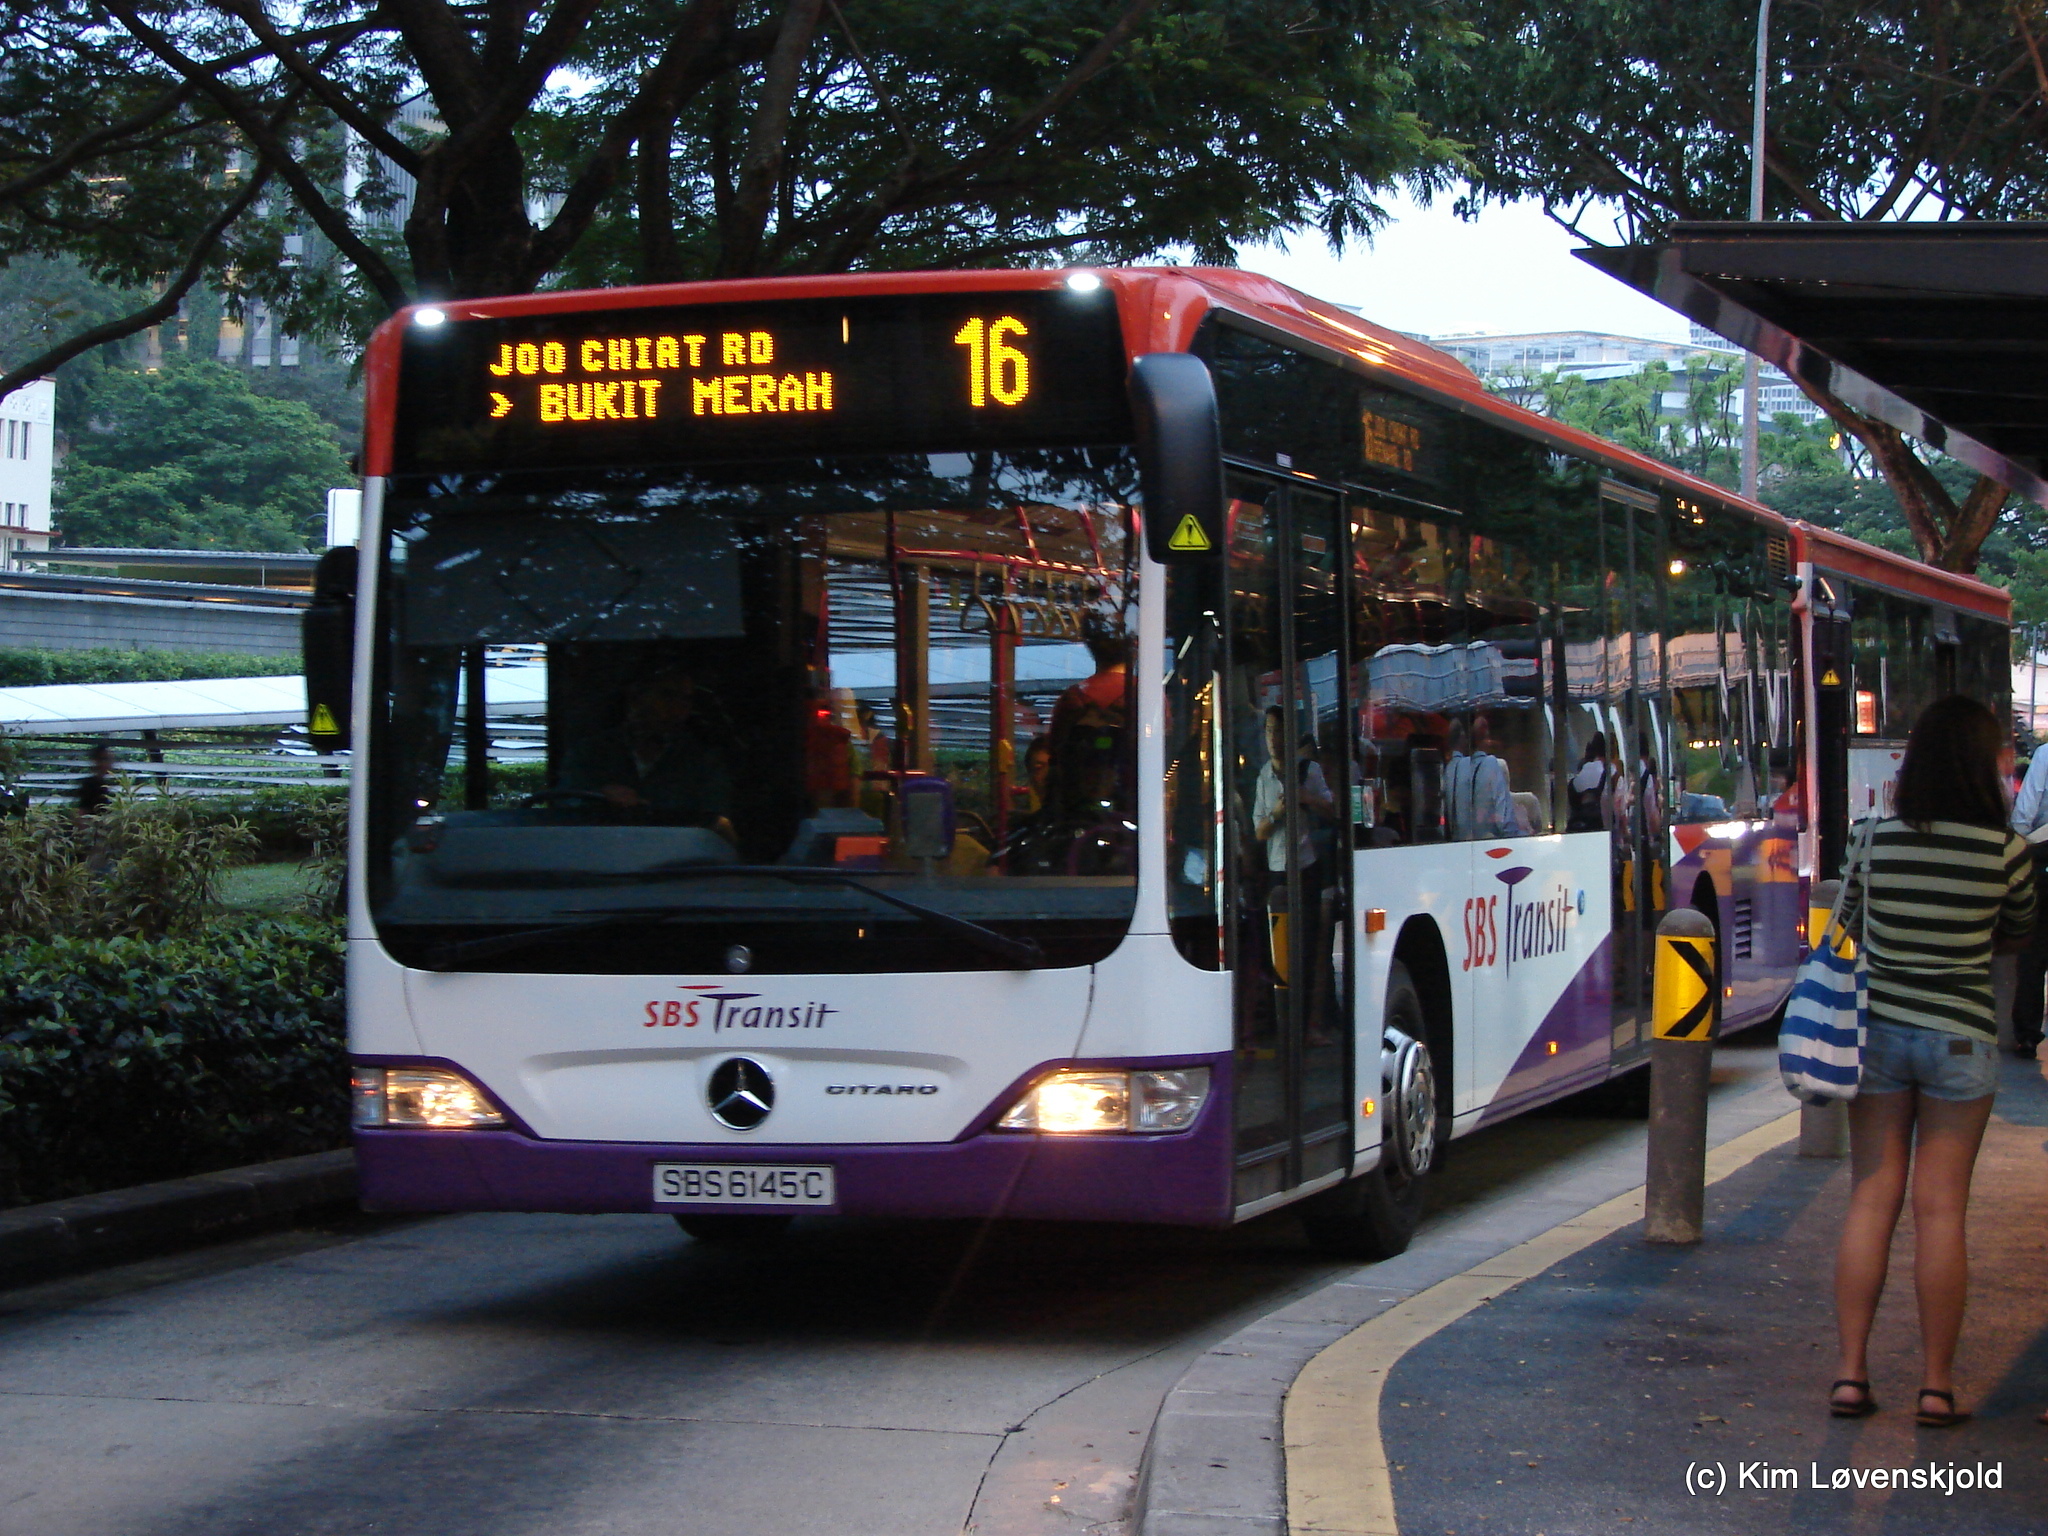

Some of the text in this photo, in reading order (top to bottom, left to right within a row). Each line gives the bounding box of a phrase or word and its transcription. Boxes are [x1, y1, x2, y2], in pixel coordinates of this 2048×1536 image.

[490, 331, 774, 376] JOO CHIAT RD
[954, 315, 1030, 407] 16
[540, 371, 833, 422] BUKIT MERAH
[1462, 866, 1574, 981] SBS Transit
[643, 993, 840, 1033] SBS Transit
[825, 1084, 939, 1096] CITARO
